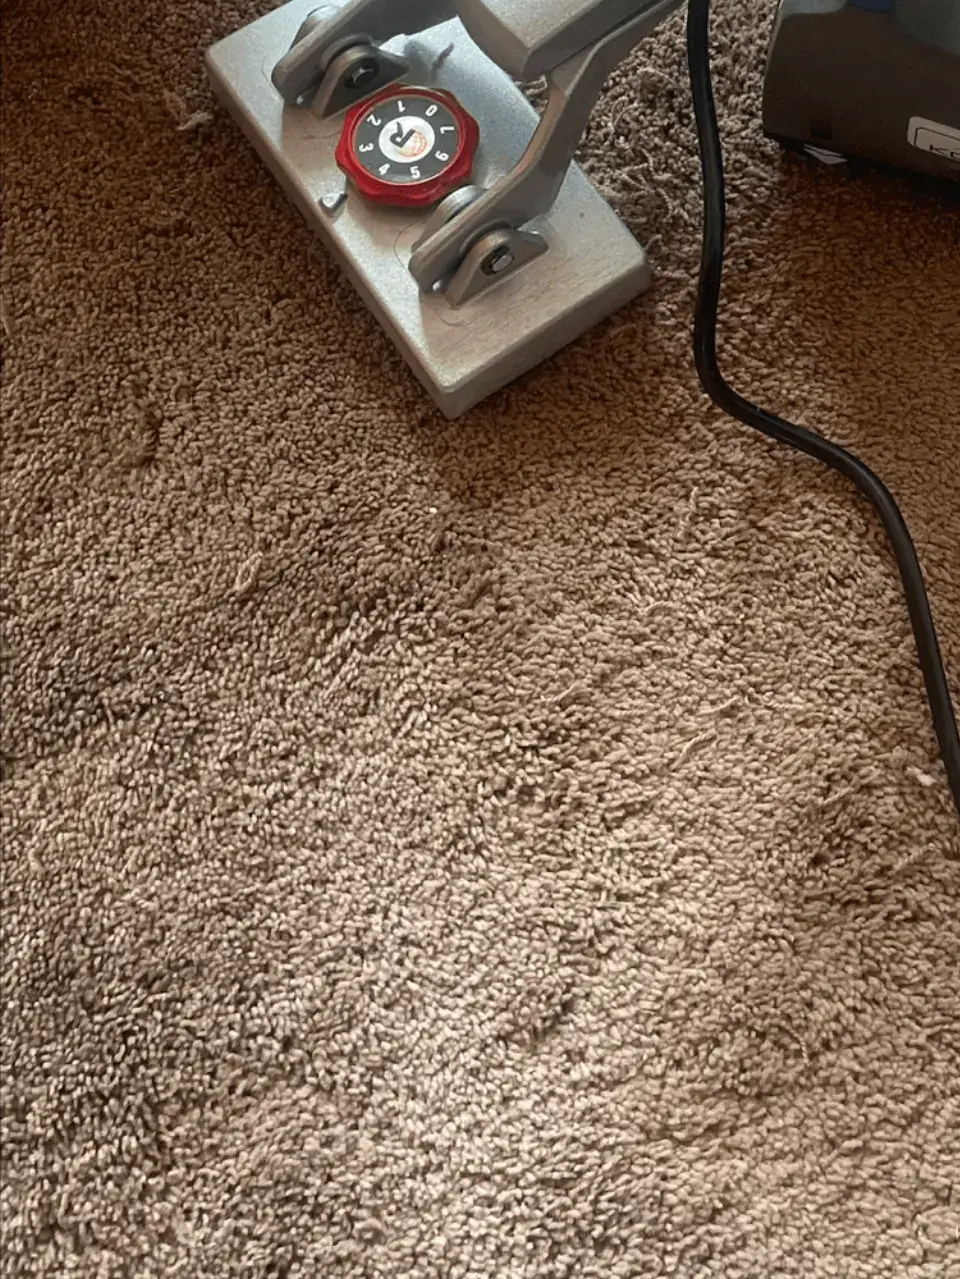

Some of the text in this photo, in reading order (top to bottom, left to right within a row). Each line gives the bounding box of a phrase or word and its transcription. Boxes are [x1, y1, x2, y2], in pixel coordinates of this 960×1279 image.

[397, 100, 405, 112] 1
[425, 105, 438, 117] 0
[366, 114, 382, 126] 2
[440, 126, 455, 134] 7
[359, 143, 374, 152] 3
[435, 150, 449, 161] 6
[378, 163, 390, 175] 4
[409, 166, 421, 179] 5
